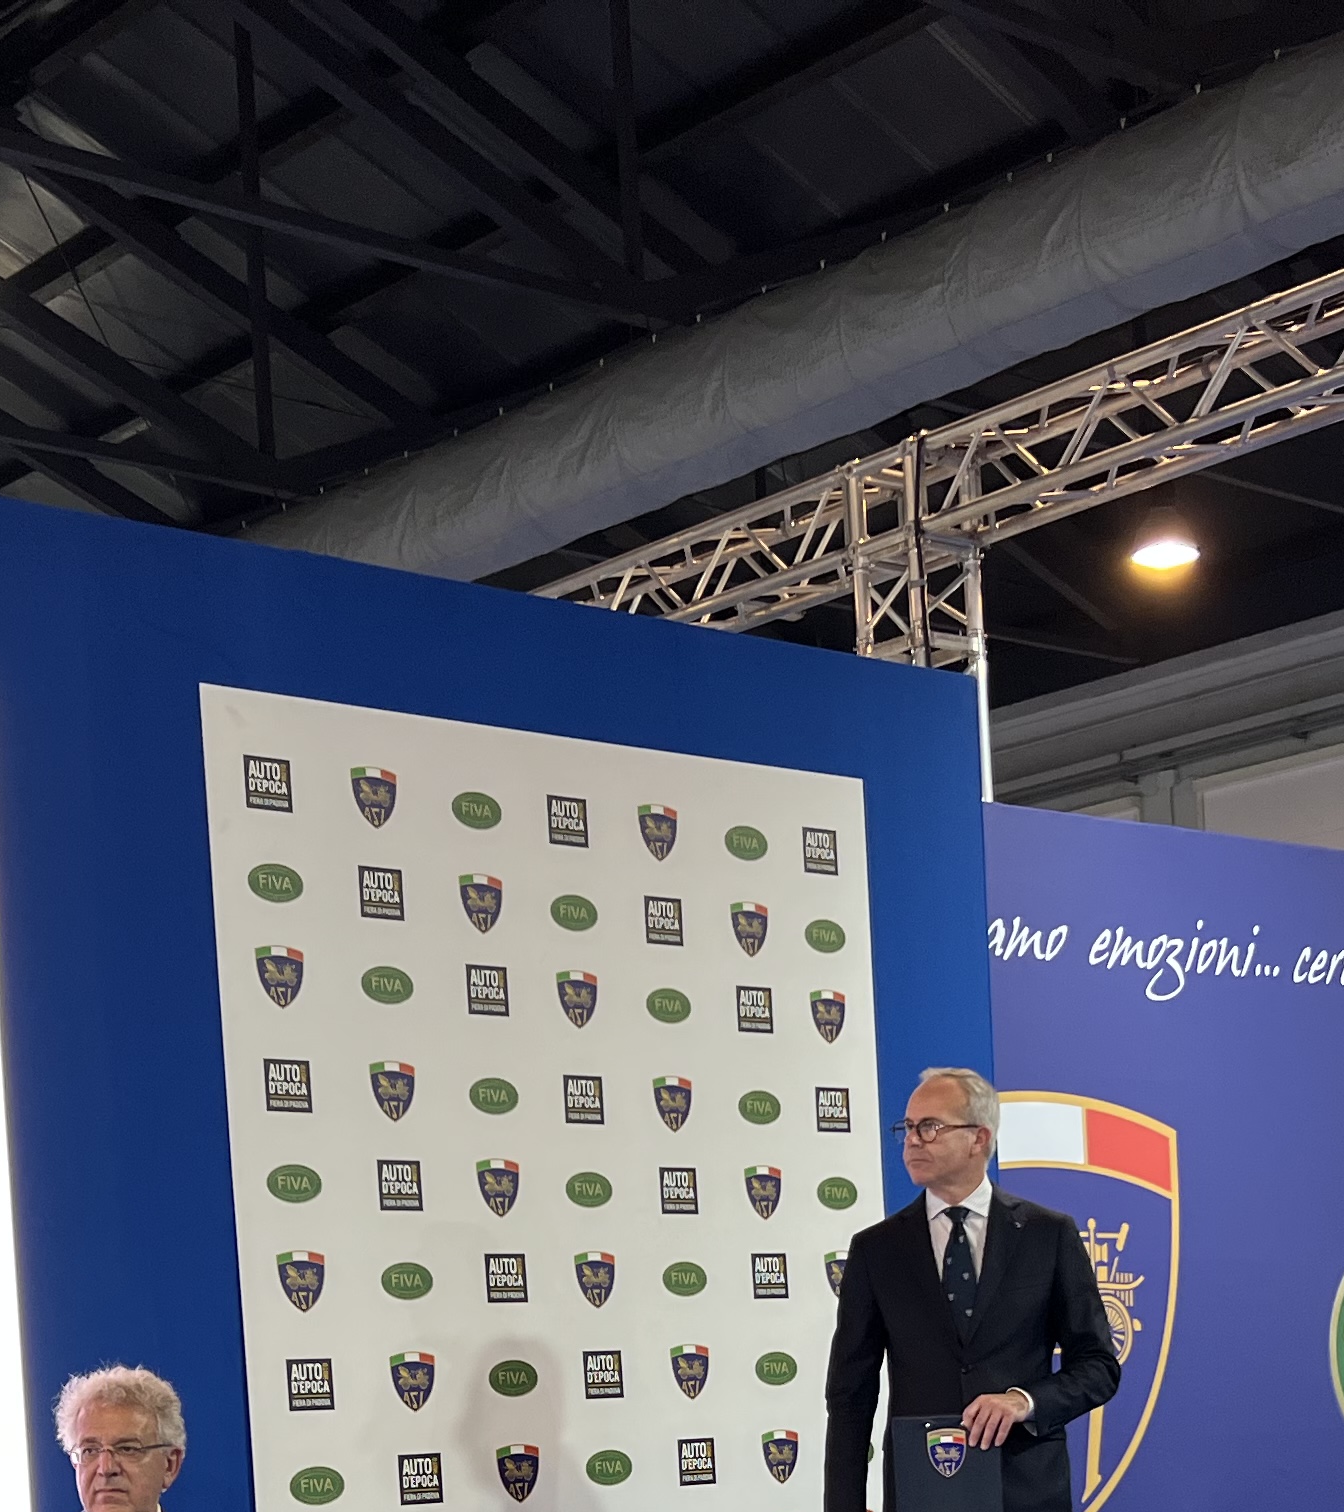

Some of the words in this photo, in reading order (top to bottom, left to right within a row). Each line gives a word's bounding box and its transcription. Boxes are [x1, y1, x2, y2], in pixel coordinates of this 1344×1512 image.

[248, 760, 281, 780] AUTO
[549, 799, 579, 818] AUTO
[805, 830, 830, 848] AUTO
[363, 870, 393, 889] AUTO
[647, 900, 674, 917] AUTO
[988, 916, 1069, 960] amo
[469, 968, 498, 986] AUTO
[739, 989, 764, 1007] AUTO
[268, 1062, 301, 1082] AUTO
[567, 1078, 594, 1096] AUTO
[818, 1090, 843, 1106] AUTO
[381, 1163, 412, 1182] AUTO
[662, 1170, 688, 1187] AUTO
[488, 1257, 517, 1274] AUTO
[754, 1256, 780, 1273] AUTO
[291, 1362, 323, 1381] AUTO
[586, 1354, 614, 1371] AUTO
[681, 1442, 707, 1459] AUTO
[402, 1458, 432, 1477] AUTO
